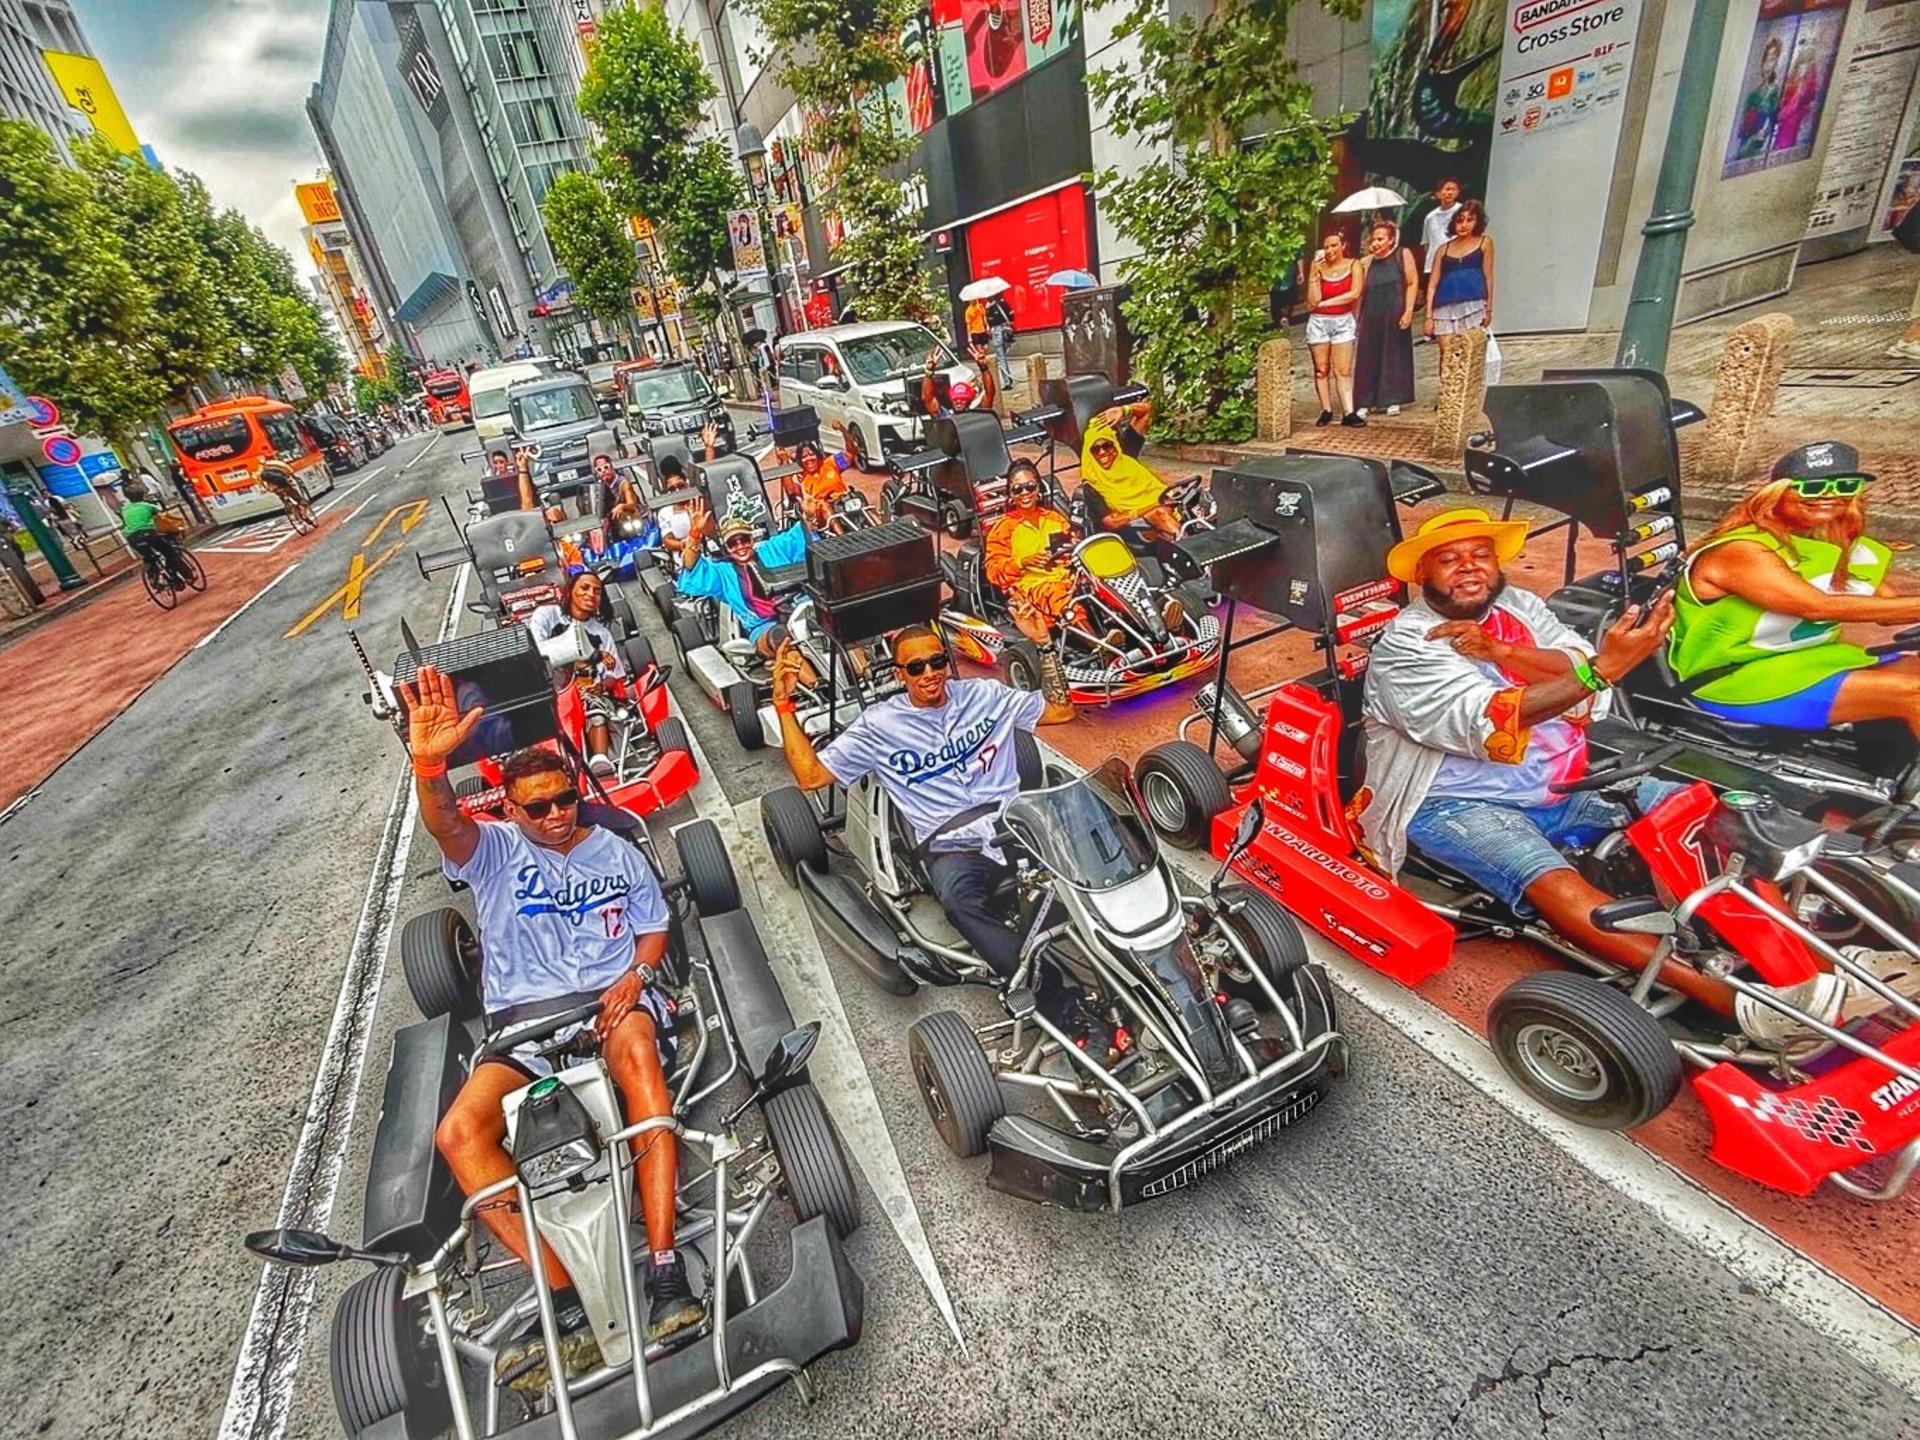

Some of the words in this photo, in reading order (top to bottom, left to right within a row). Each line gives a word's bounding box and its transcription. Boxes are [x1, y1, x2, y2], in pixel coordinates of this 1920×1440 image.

[1517, 26, 1567, 54] Cross
[1569, 7, 1624, 36] Store
[504, 538, 515, 553] 6
[1342, 580, 1393, 605] RENTHAL
[888, 715, 998, 774] Dodgers
[978, 743, 998, 775] 17
[1239, 811, 1391, 900] ANDARDMOTO
[514, 864, 631, 928] Ddgers
[601, 907, 623, 939] 17
